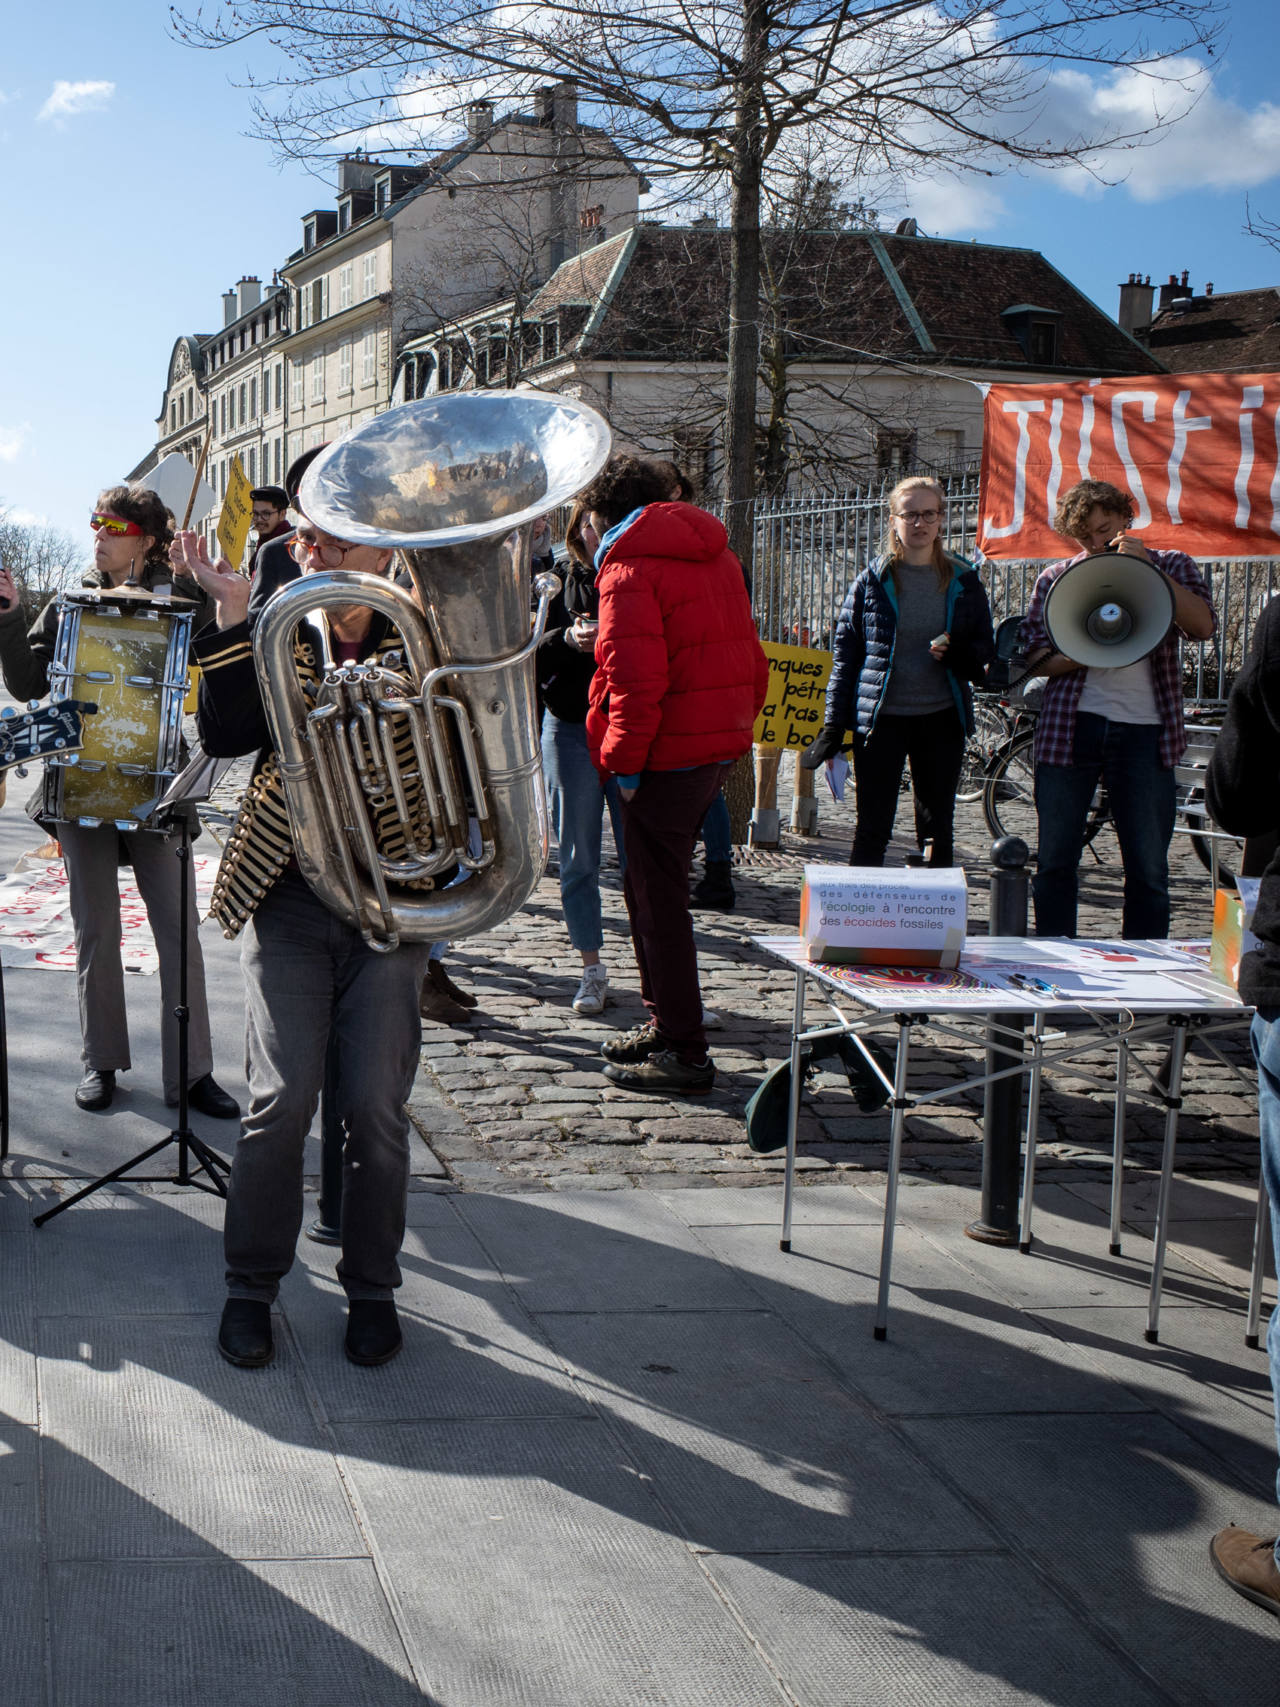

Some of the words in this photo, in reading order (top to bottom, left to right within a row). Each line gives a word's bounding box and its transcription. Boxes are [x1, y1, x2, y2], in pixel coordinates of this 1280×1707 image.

[768, 657, 823, 683] nques
[781, 681, 826, 706] pétr
[784, 703, 820, 723] ras
[760, 720, 776, 742] le
[819, 890, 843, 898] des
[853, 890, 931, 901] défenseurs
[940, 893, 957, 902] de
[820, 902, 876, 915] l'écologie
[882, 903, 890, 914] à
[897, 903, 956, 916] l'encontre
[820, 916, 841, 926] des
[844, 916, 896, 928] écocides
[900, 918, 944, 929] fossiles
